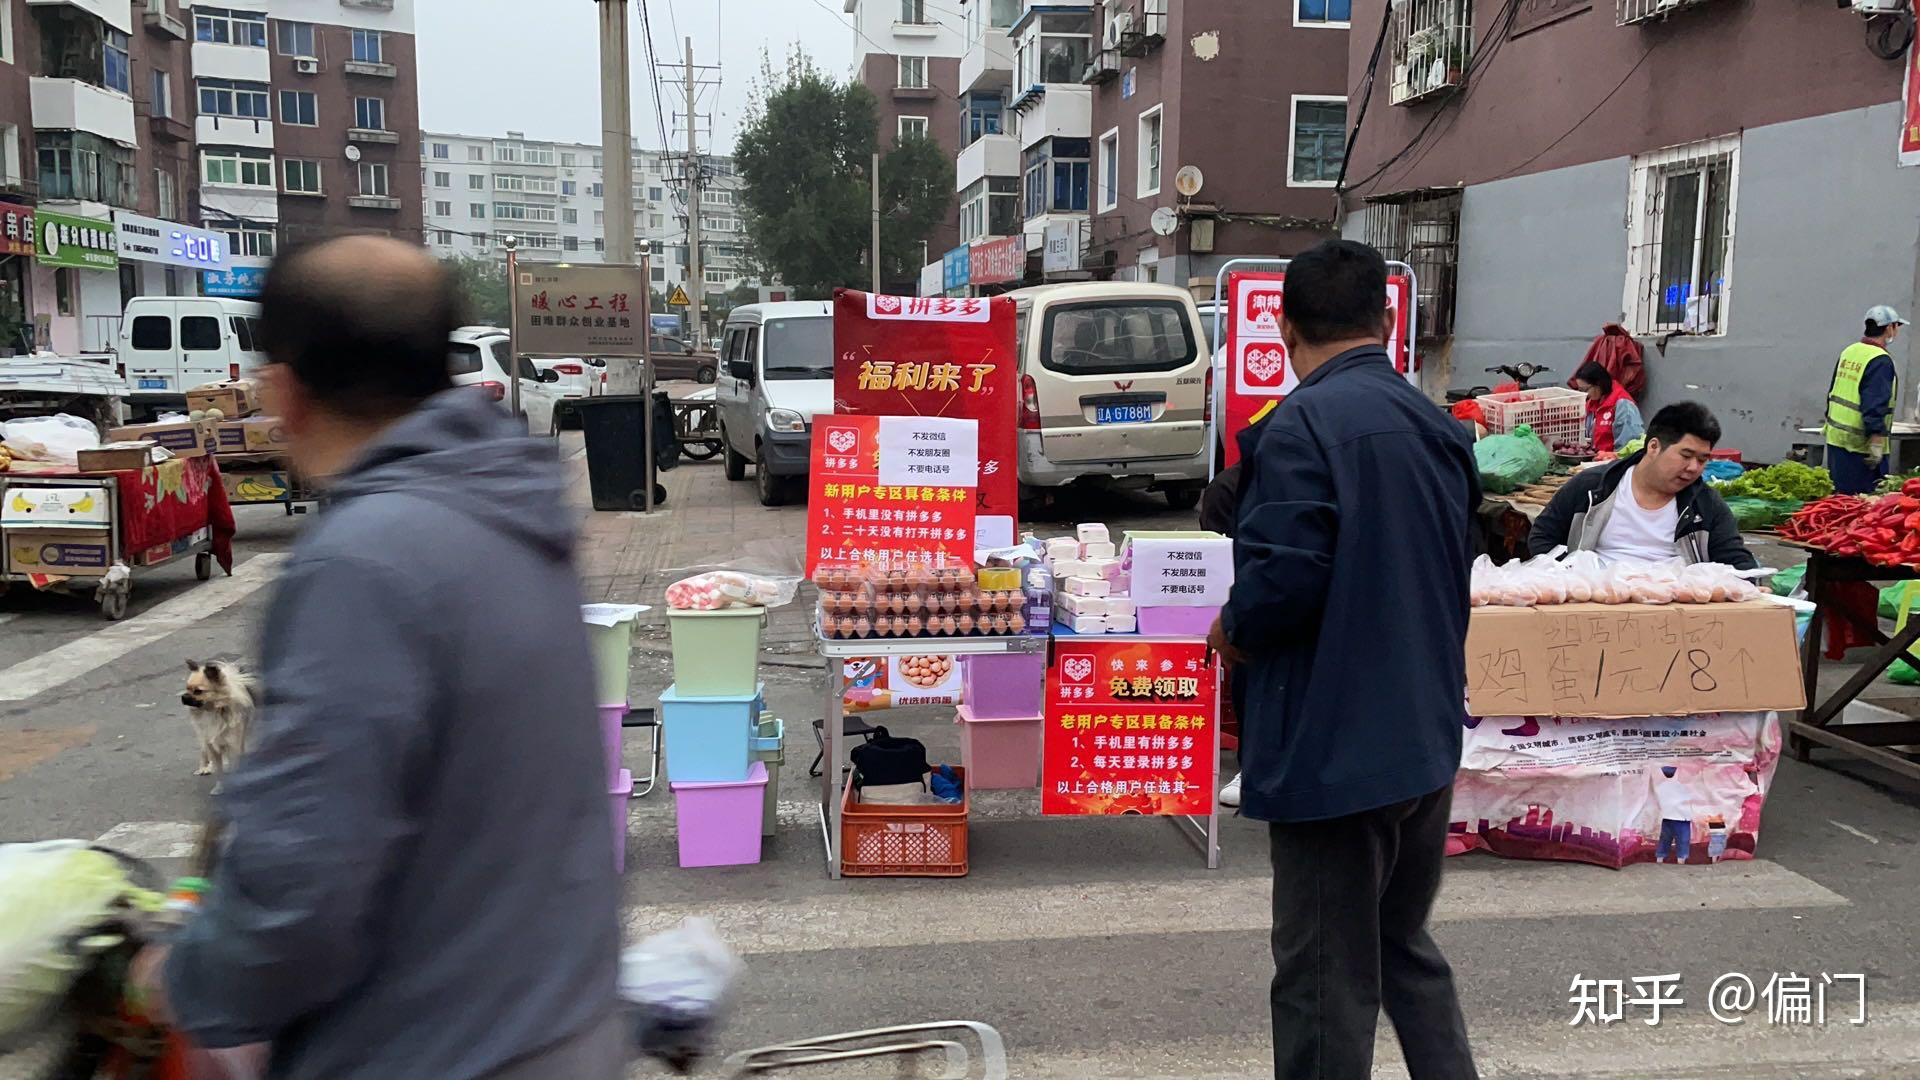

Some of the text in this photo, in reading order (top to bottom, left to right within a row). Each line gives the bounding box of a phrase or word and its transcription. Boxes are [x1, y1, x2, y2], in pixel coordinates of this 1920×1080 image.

[0, 210, 34, 243] 串店
[531, 290, 630, 312] 暖心工程
[908, 297, 981, 316] 拼多多
[530, 315, 630, 328] 困难群众创业基地
[912, 432, 946, 441] 不发微信
[907, 448, 951, 458] 不发朋友圈
[824, 457, 859, 470] 拼多多
[907, 464, 951, 474] 不要电话号
[824, 483, 967, 503] 新用户专区具备条件
[820, 547, 961, 563] 以上合格用户任选其一
[1166, 551, 1203, 561] 不发微信
[1161, 568, 1207, 577] 不发朋友圈
[1161, 585, 1206, 594] 不要电话号
[1110, 658, 1198, 672] 快来参与
[1060, 686, 1095, 699] 拼多多
[1108, 677, 1199, 698] 免费领取
[898, 696, 952, 705] 优选鲜鸡蛋
[1060, 714, 1206, 730] 老用户专区具备条件
[1057, 780, 1200, 795] 以上合格用户任选其一
